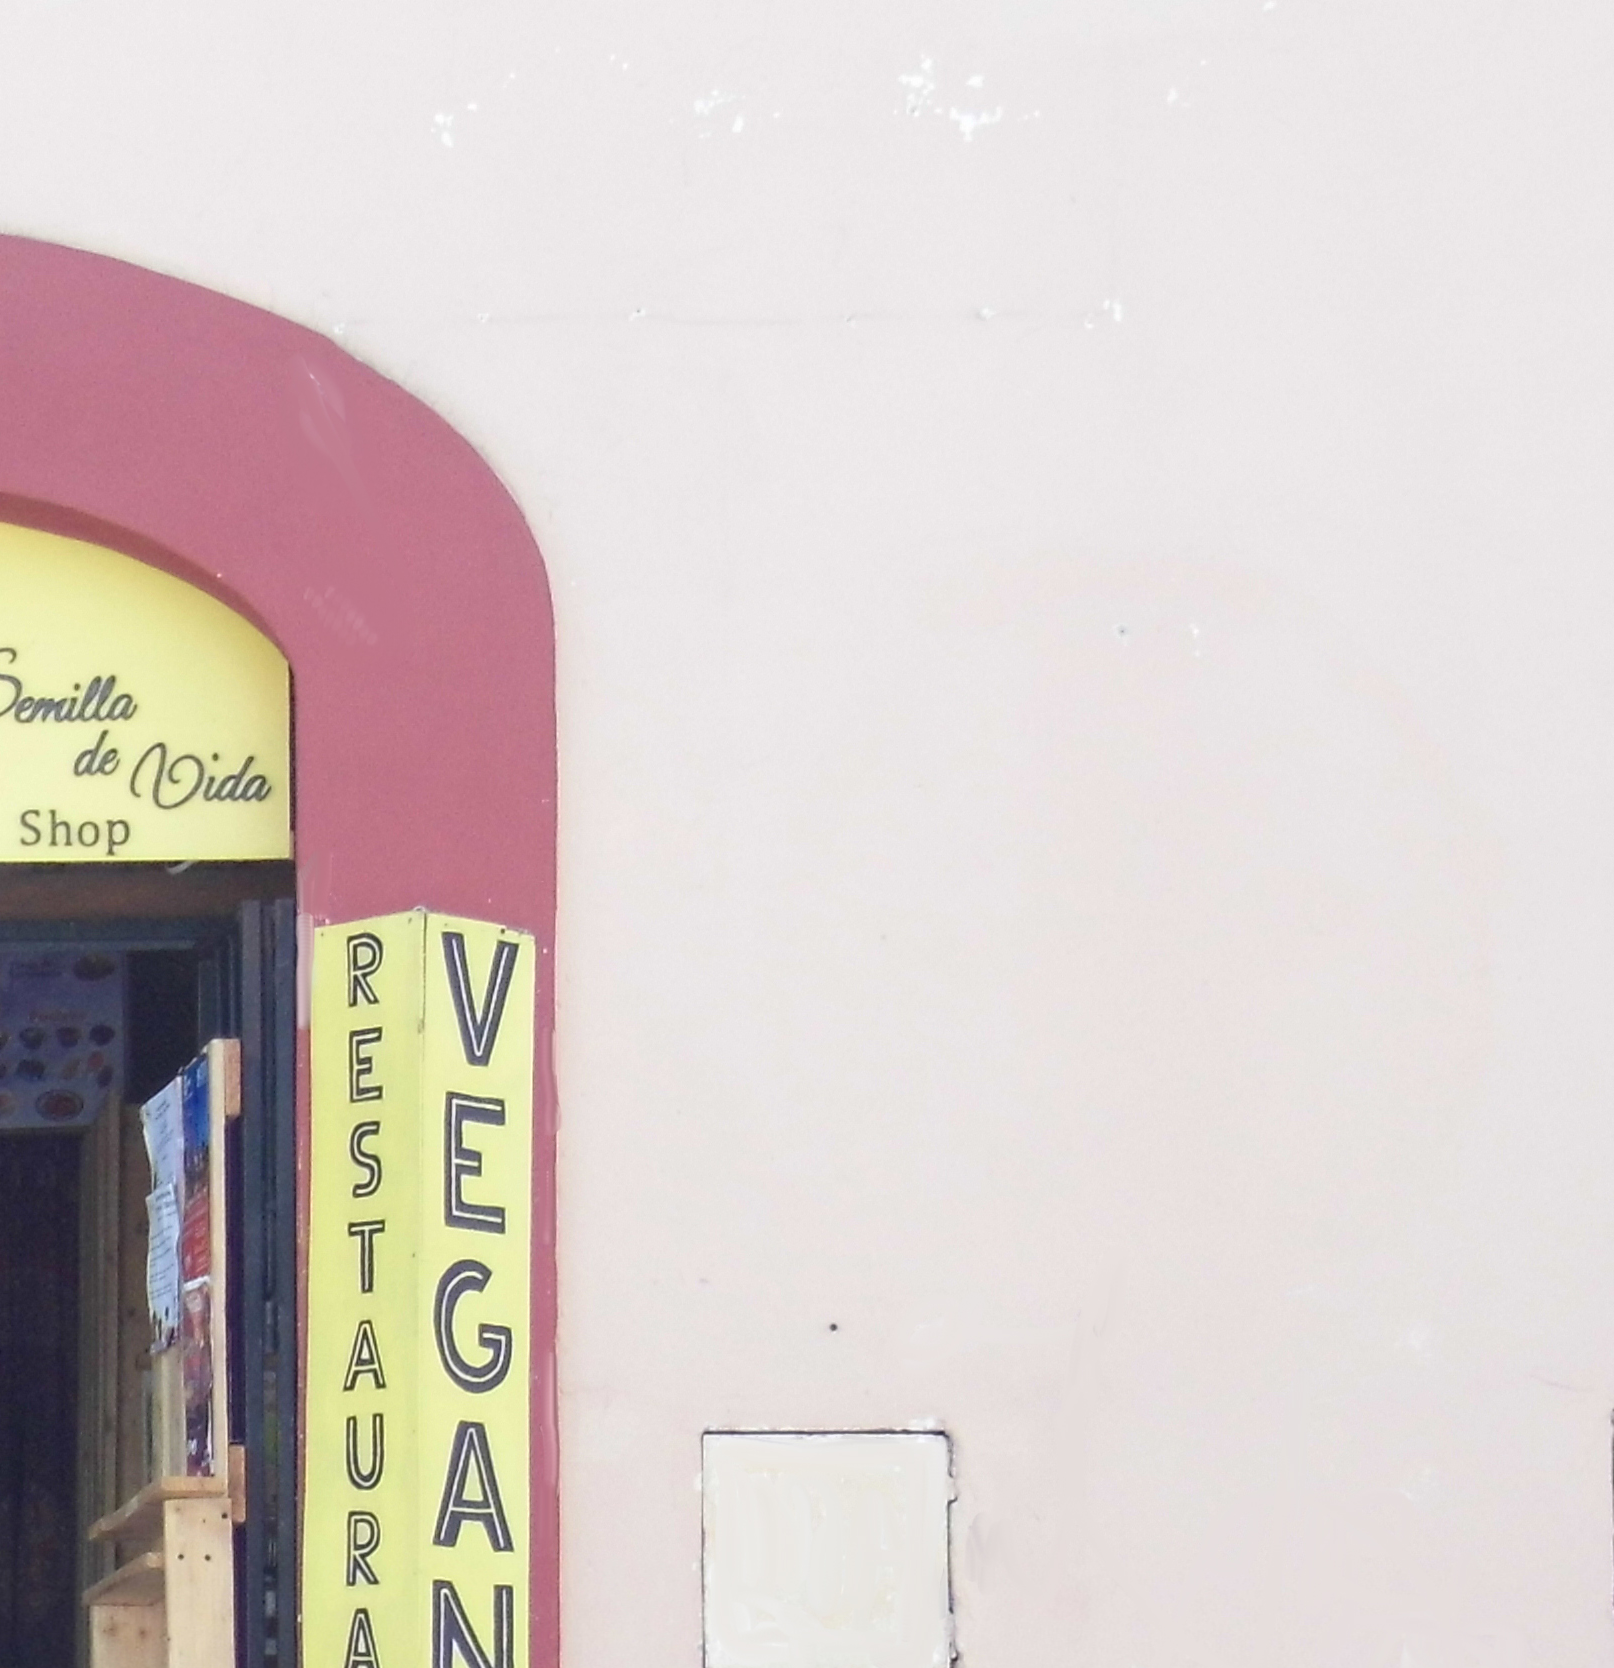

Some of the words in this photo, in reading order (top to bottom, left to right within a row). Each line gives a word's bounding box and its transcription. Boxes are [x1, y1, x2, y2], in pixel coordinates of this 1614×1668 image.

[74, 731, 119, 777] de
[130, 742, 272, 809] Vida
[19, 808, 132, 856] Shop
